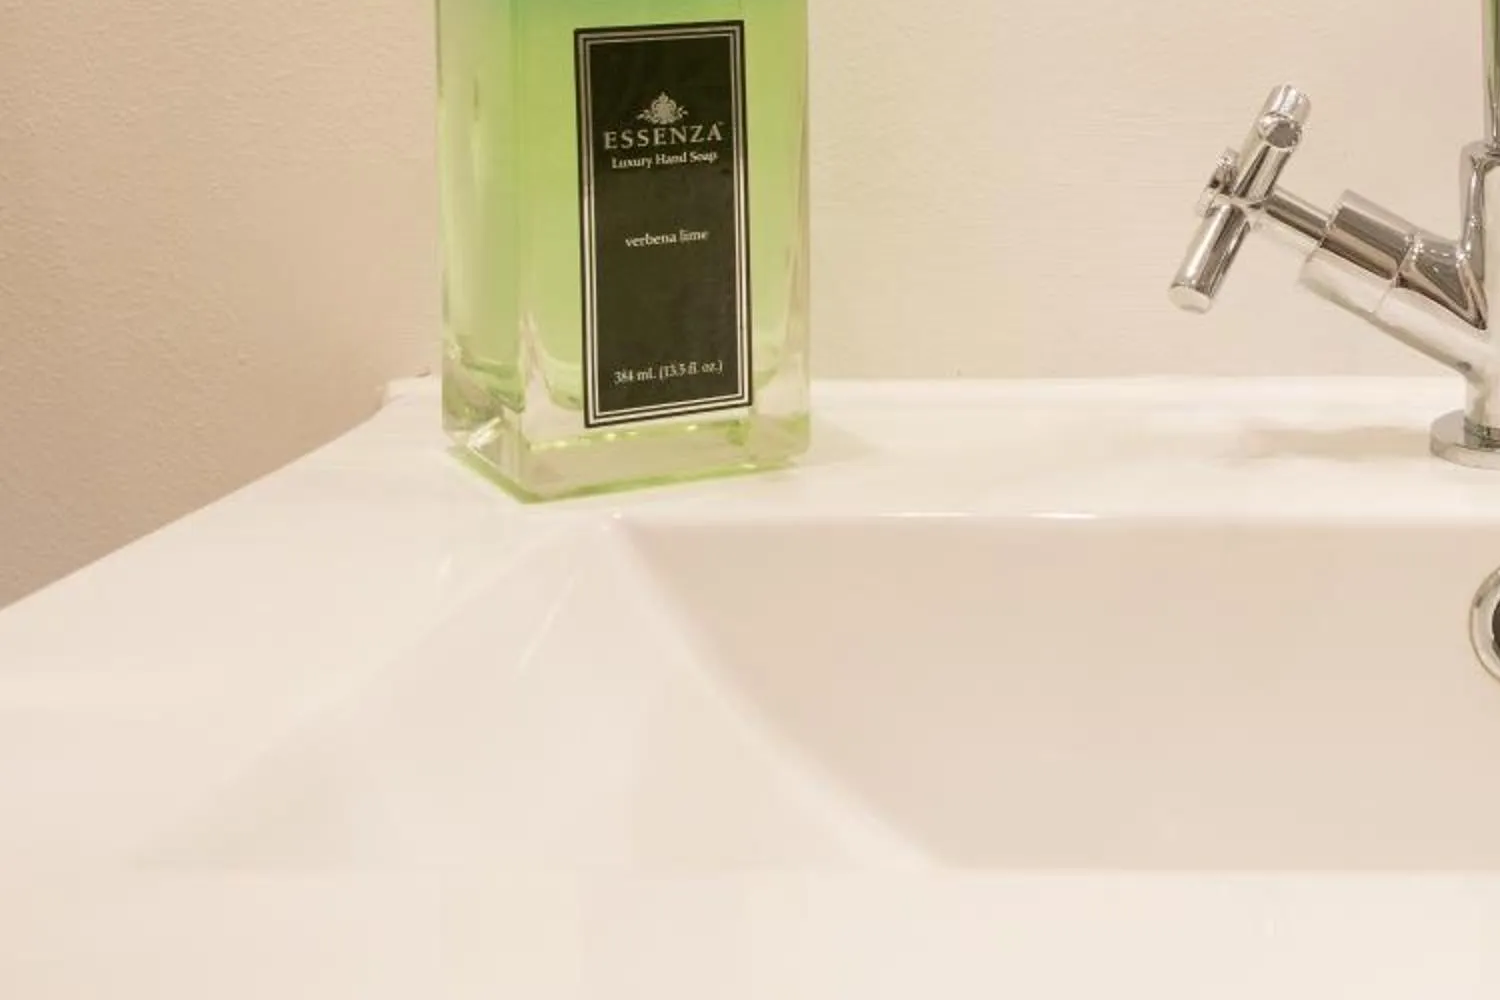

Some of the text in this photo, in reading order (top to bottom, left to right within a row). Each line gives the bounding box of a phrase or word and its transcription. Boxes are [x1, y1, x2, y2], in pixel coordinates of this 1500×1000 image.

[604, 123, 722, 149] ESSENZA
[612, 151, 717, 168] Luxury Hand Soap
[625, 229, 710, 248] verbena lime
